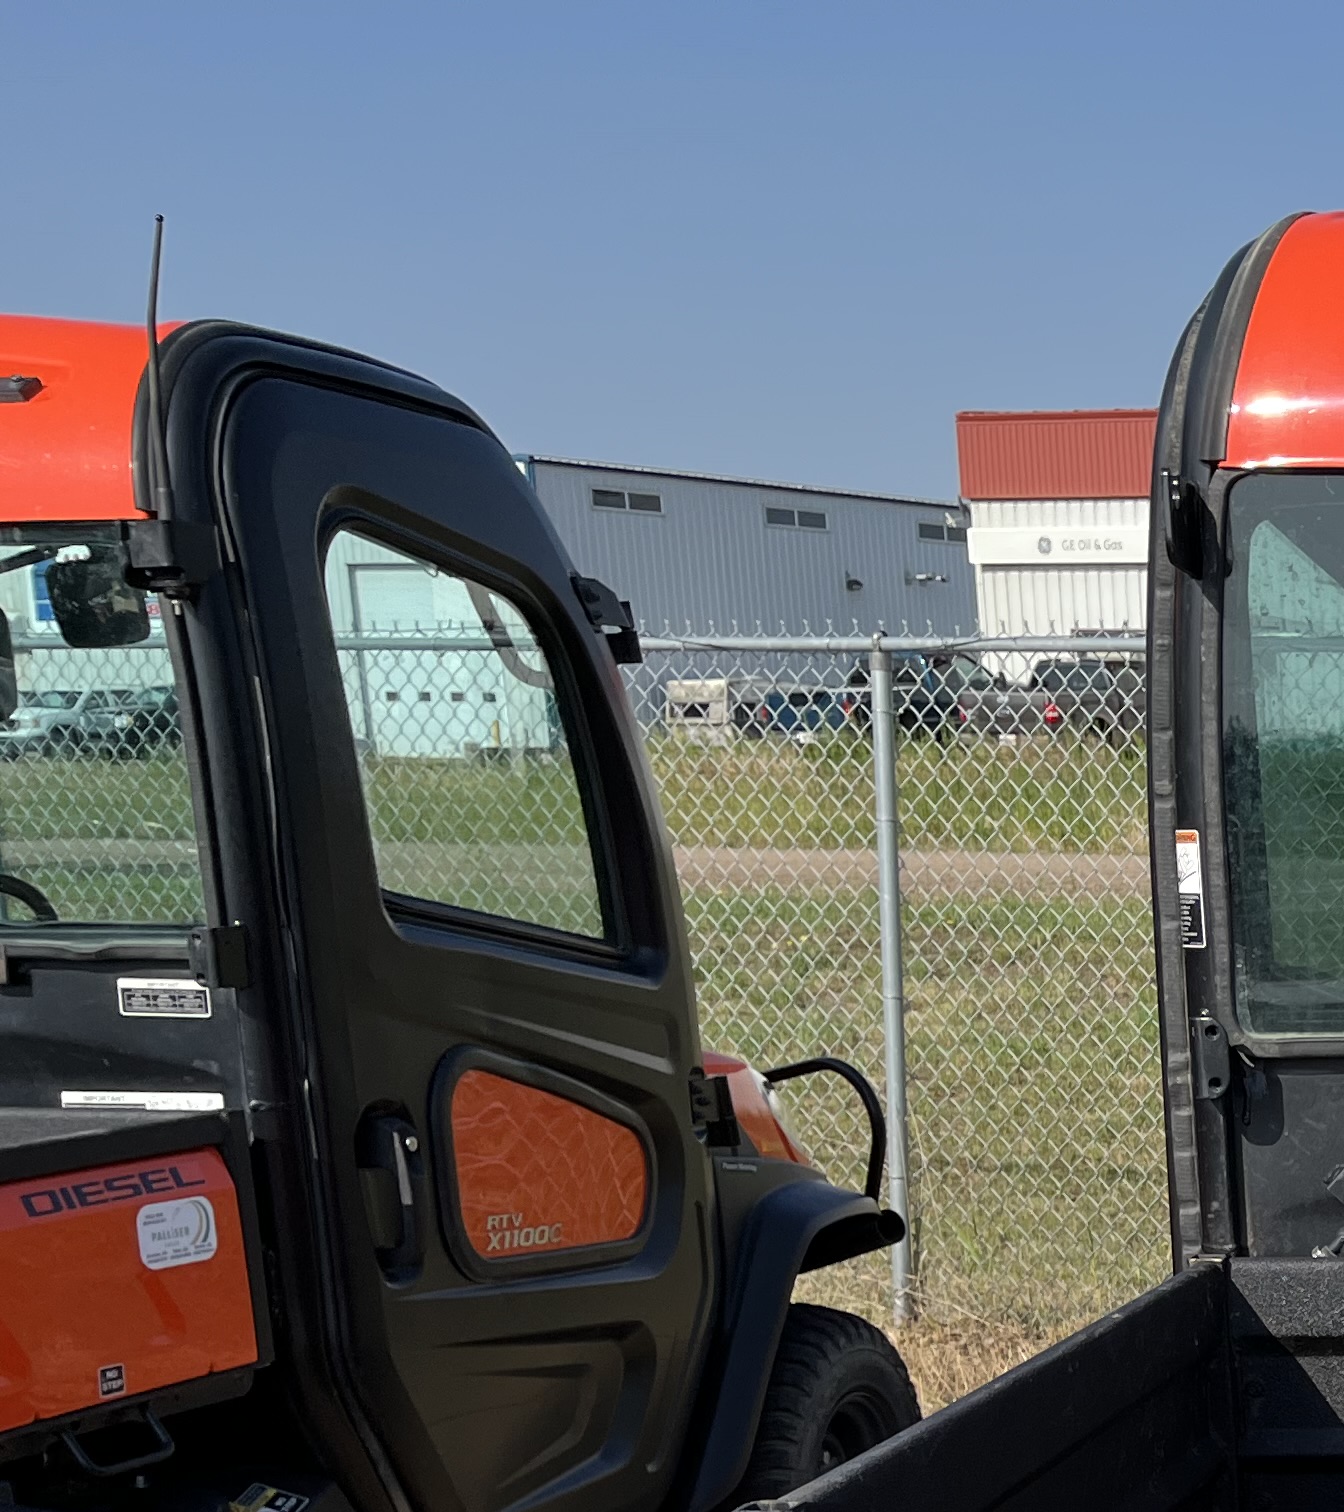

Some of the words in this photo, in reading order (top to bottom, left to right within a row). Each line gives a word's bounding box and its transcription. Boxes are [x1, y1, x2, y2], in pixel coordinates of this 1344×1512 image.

[20, 1166, 206, 1218] DIESEL
[487, 1212, 523, 1231] RTV
[487, 1222, 563, 1252] X1100C
